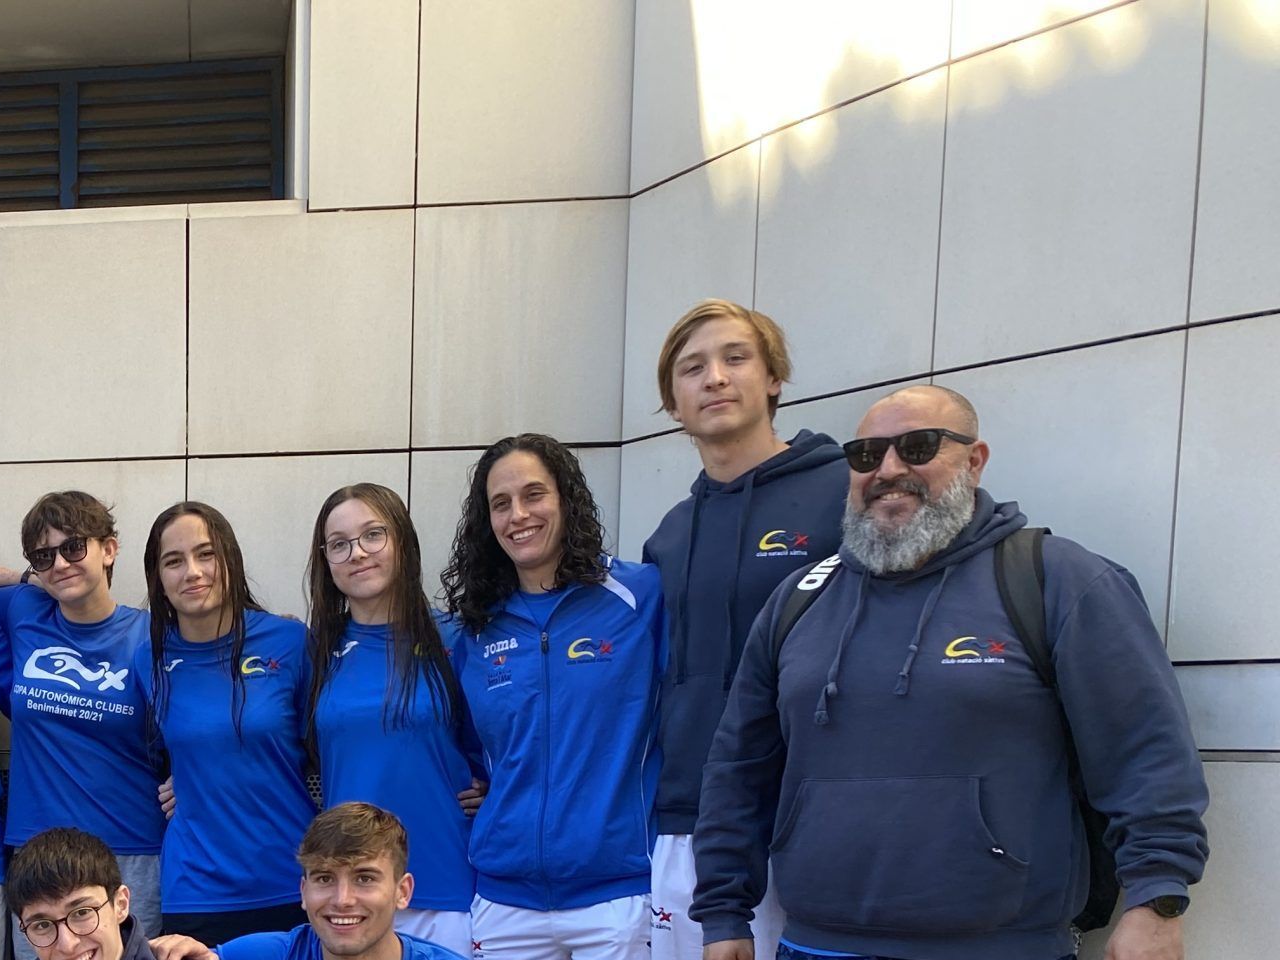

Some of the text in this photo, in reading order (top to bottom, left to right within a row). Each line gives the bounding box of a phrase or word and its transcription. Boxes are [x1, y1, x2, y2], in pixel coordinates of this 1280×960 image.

[483, 637, 519, 658] Joma
[26, 699, 103, 722] Benimámet 20/21
[28, 688, 93, 708] AUTONÓMICA
[95, 700, 135, 716] CLUBES
